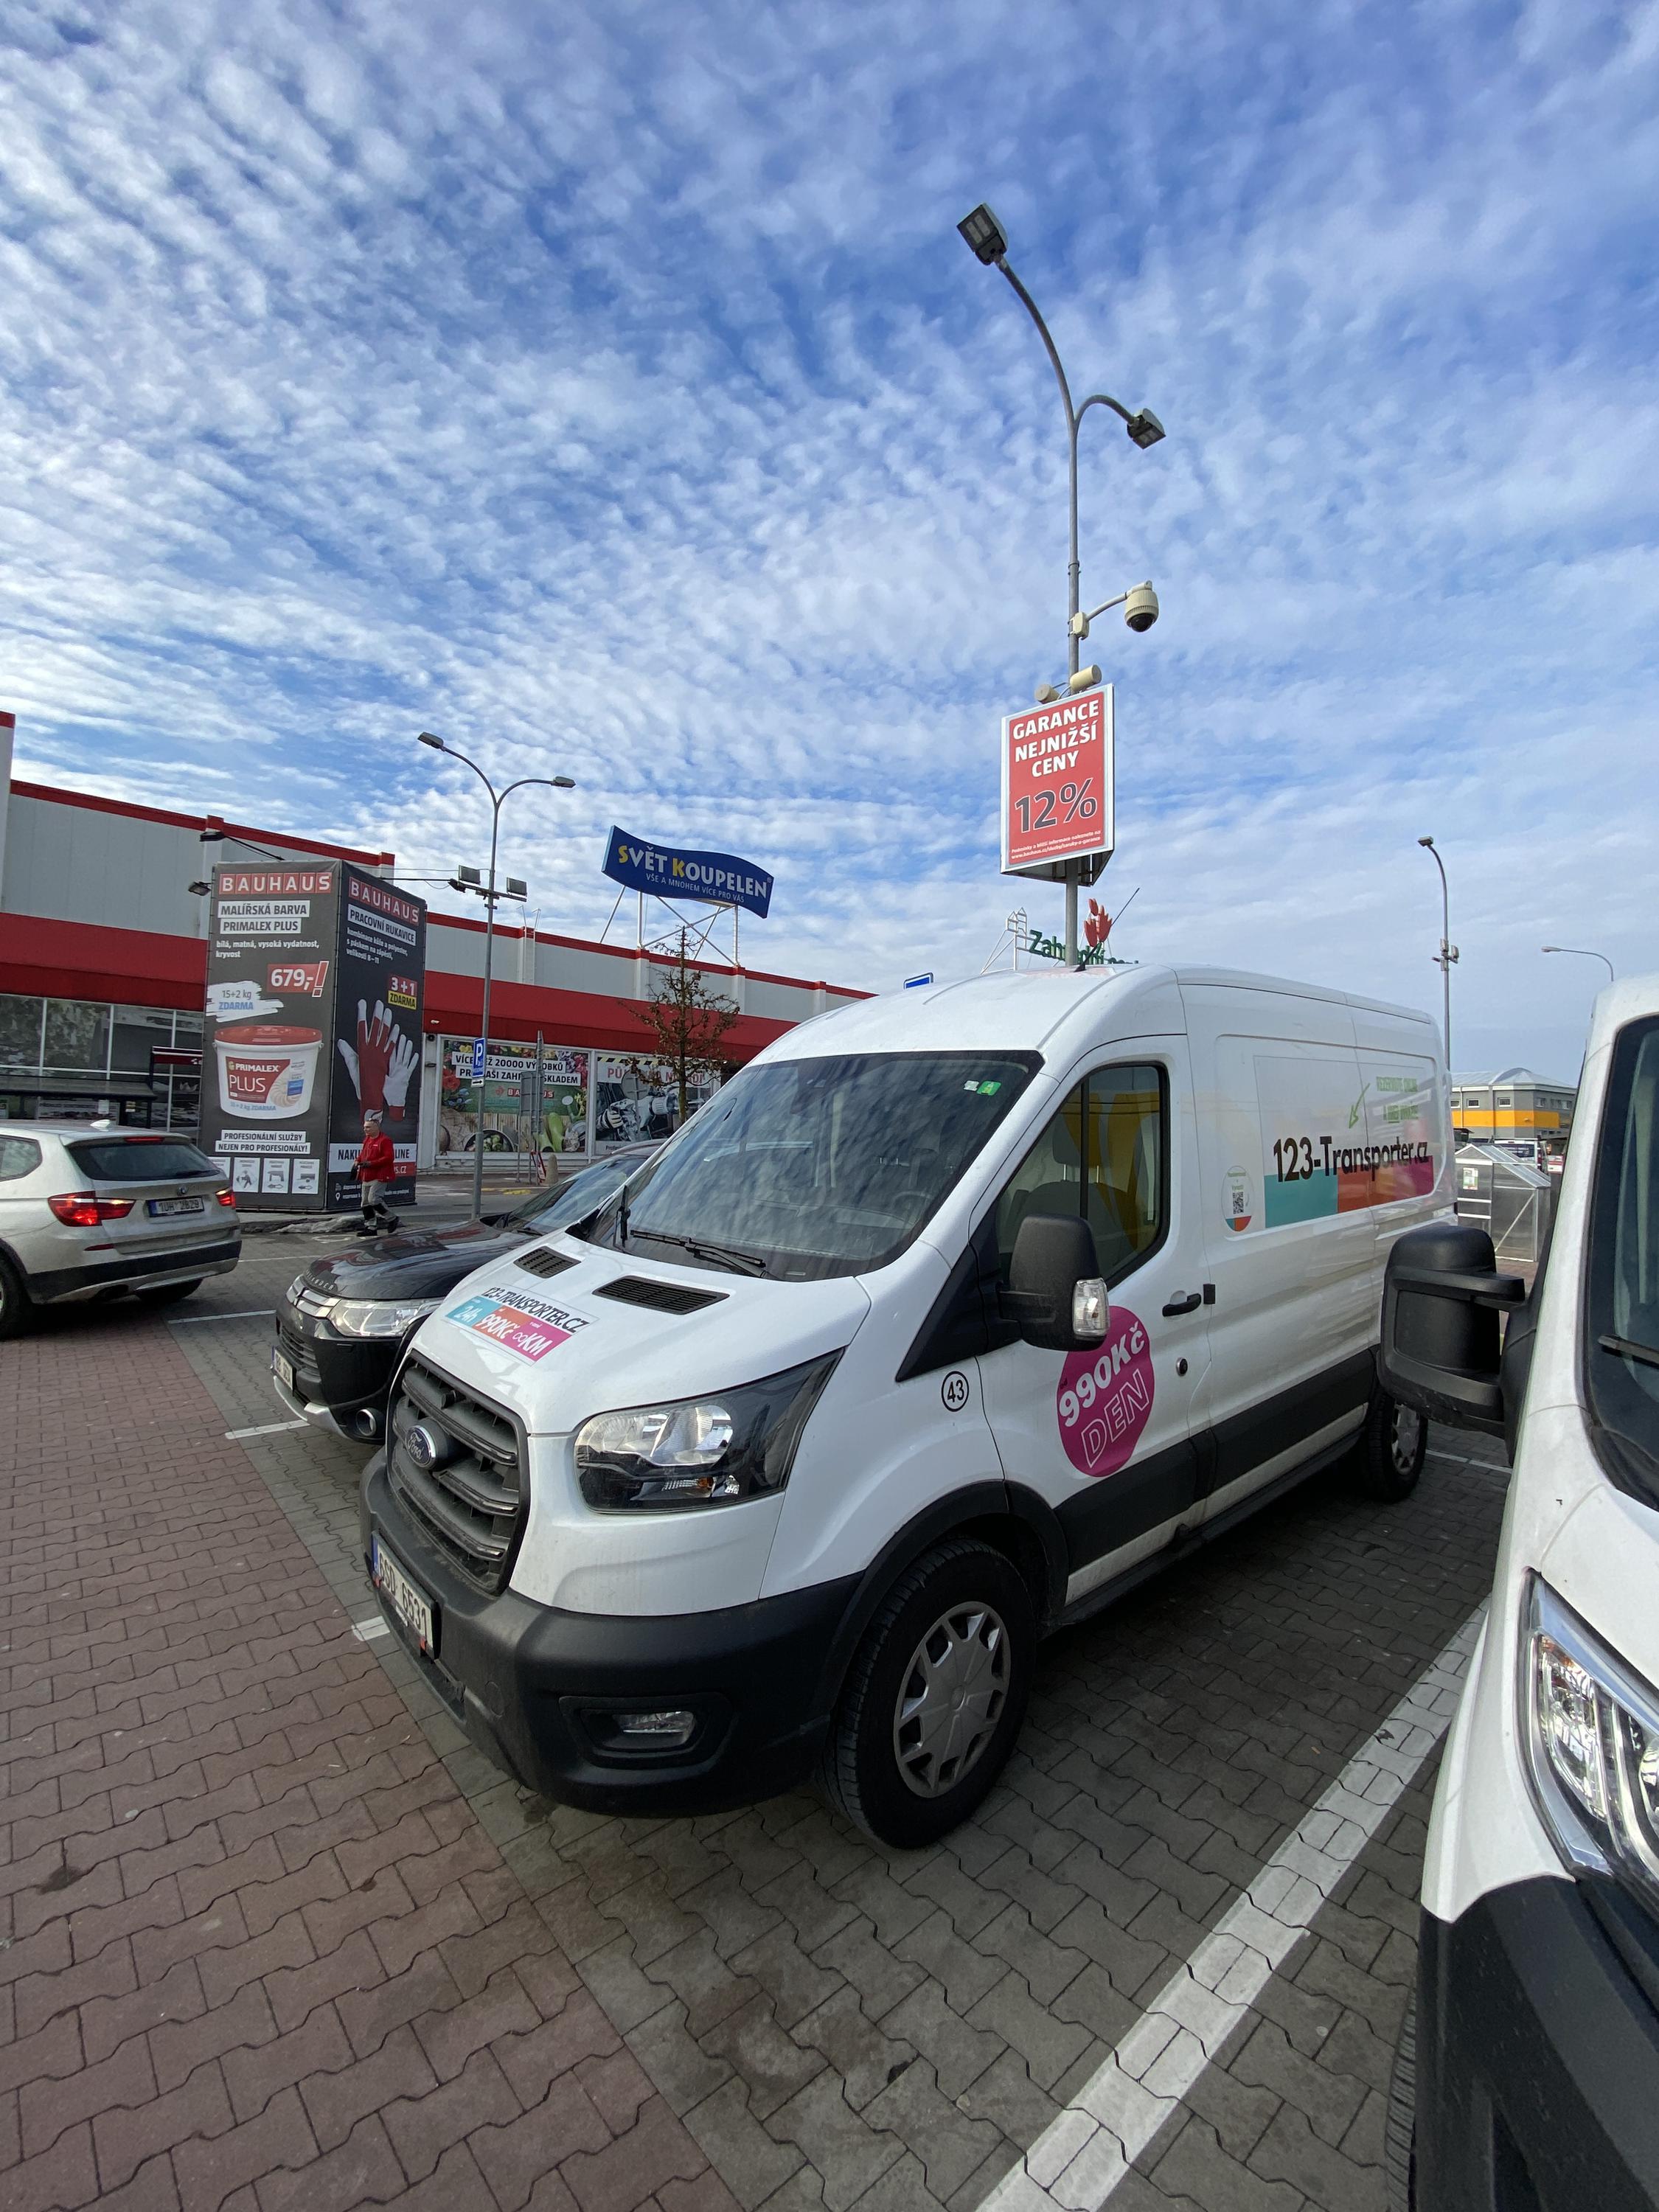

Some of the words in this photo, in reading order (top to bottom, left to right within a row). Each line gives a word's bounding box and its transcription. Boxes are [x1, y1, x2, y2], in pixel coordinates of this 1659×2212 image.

[1012, 699, 1099, 740] GARANCE
[1015, 720, 1098, 762] NEJNIŽŠÍ
[1032, 750, 1079, 778] CENY
[1015, 777, 1097, 833] 12%
[618, 845, 668, 873] SVĚT
[672, 858, 768, 898] KOUPELEN
[222, 875, 330, 892] BAUHAUS
[646, 873, 659, 883] VŠE
[668, 878, 700, 892] MNOHEM
[701, 885, 717, 897] VÍCE
[718, 890, 731, 900] PRO
[732, 891, 745, 903] VÁS
[220, 902, 271, 915] MALÍŘSKÁ
[274, 903, 307, 914] BARVA
[351, 881, 420, 922] BAUHAUS
[223, 921, 271, 931] PRIMALEX
[274, 920, 298, 931] PLUS
[350, 910, 384, 931] PRACOVNÍ
[386, 924, 414, 943] RUKAVICE
[258, 941, 282, 949] vysoká
[283, 940, 320, 949] vydatnost,
[391, 976, 416, 995] 3+1
[243, 990, 251, 1001] kg
[389, 993, 416, 1008] ZDARMA
[219, 1002, 253, 1010] ZDARMA
[476, 1043, 483, 1065] P
[236, 1062, 279, 1072] PRIMALEX
[495, 1059, 524, 1068] 20000
[526, 1060, 563, 1071] VÝOBKŮ
[229, 1074, 265, 1092] PLUS
[224, 1133, 276, 1141] PROFESIONÁLNÍ
[279, 1133, 302, 1141] SLUŽBY
[257, 1144, 307, 1152] PROFESIONÁLY!
[454, 1306, 482, 1323] 24h
[481, 1287, 591, 1333] 123-TRANSPORTER.CZ
[947, 1379, 965, 1404] 43
[1081, 1368, 1150, 1469] DEN
[408, 1433, 425, 1460] Ford
